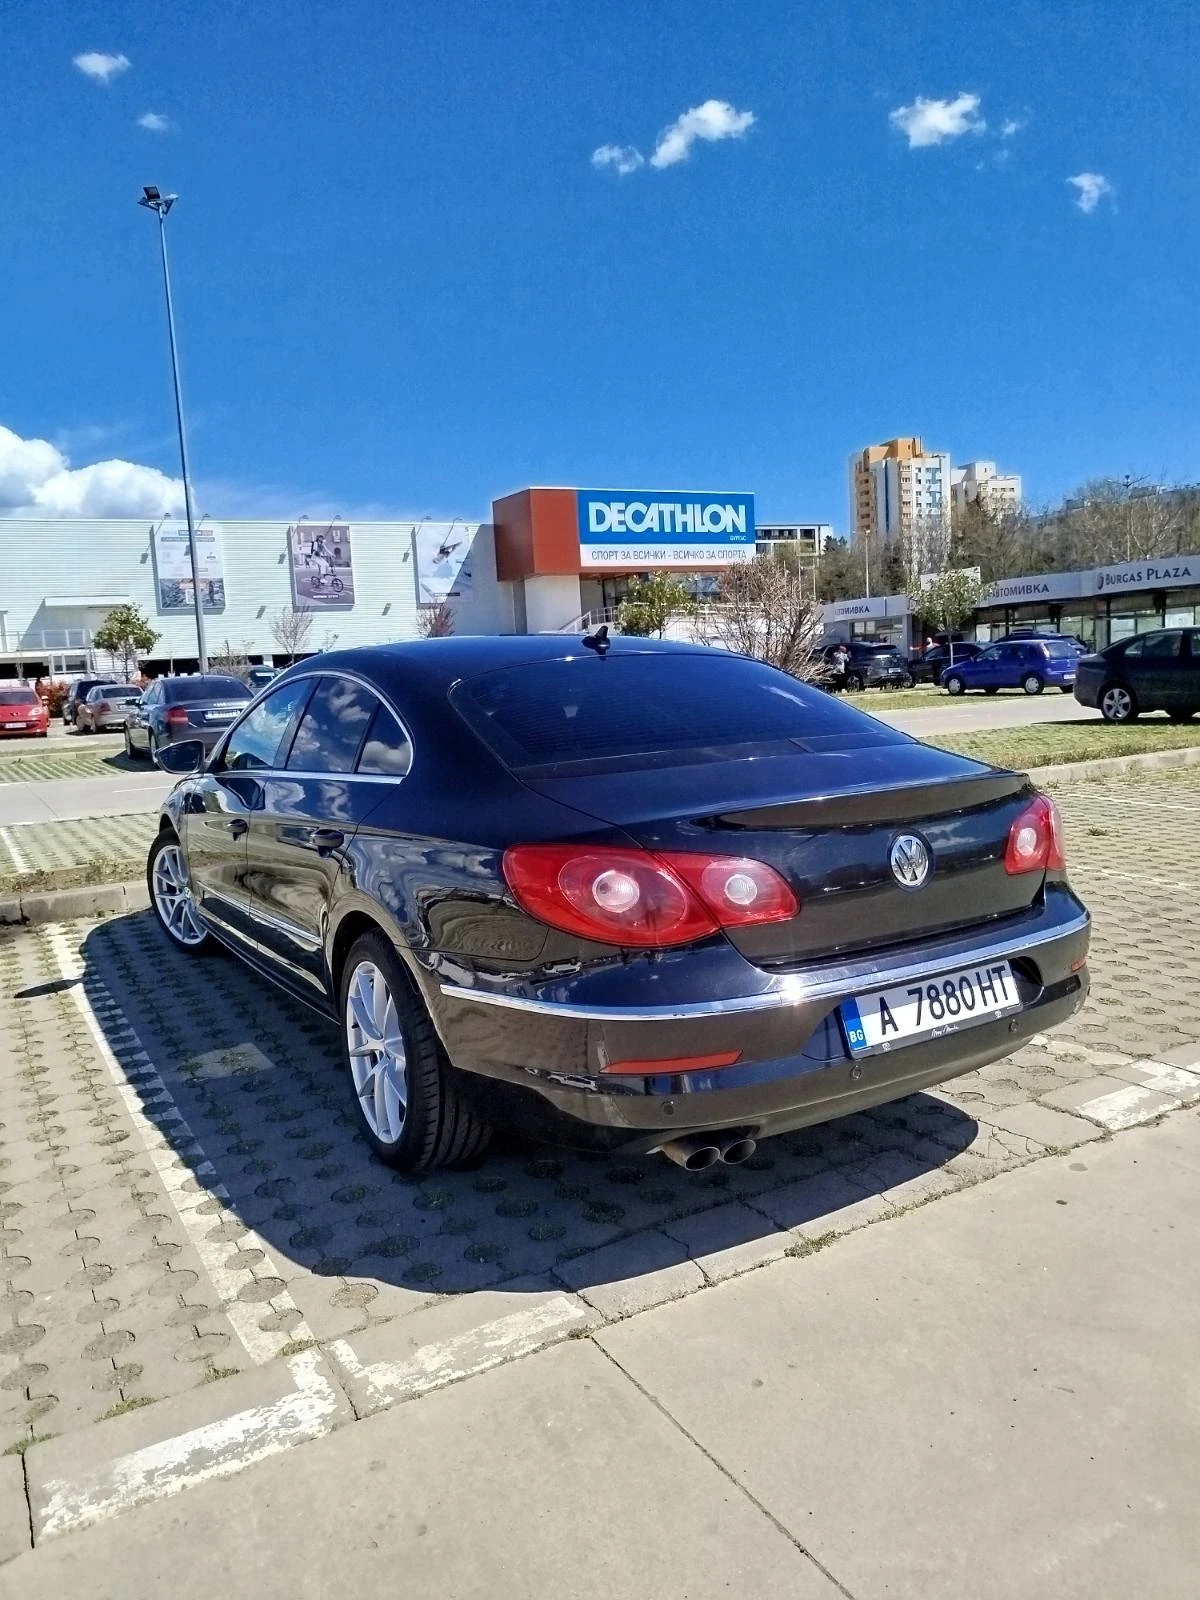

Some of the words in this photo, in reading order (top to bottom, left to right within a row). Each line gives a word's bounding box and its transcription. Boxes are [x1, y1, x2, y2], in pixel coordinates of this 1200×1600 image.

[588, 502, 746, 532] DECATHLON
[591, 550, 619, 561] СПОРТ
[621, 550, 631, 560] ЗА
[634, 550, 666, 560] ВСИЧКИ
[673, 550, 704, 560] ВСИЧКО
[706, 550, 717, 560] ЗА
[718, 549, 747, 560] СПОРТА
[1106, 571, 1142, 585] BURGAS
[1146, 567, 1192, 581] PLAZA
[879, 996, 899, 1035] A
[907, 975, 976, 1026] 7880
[975, 965, 1008, 1007] HT
[849, 1028, 864, 1043] BG
